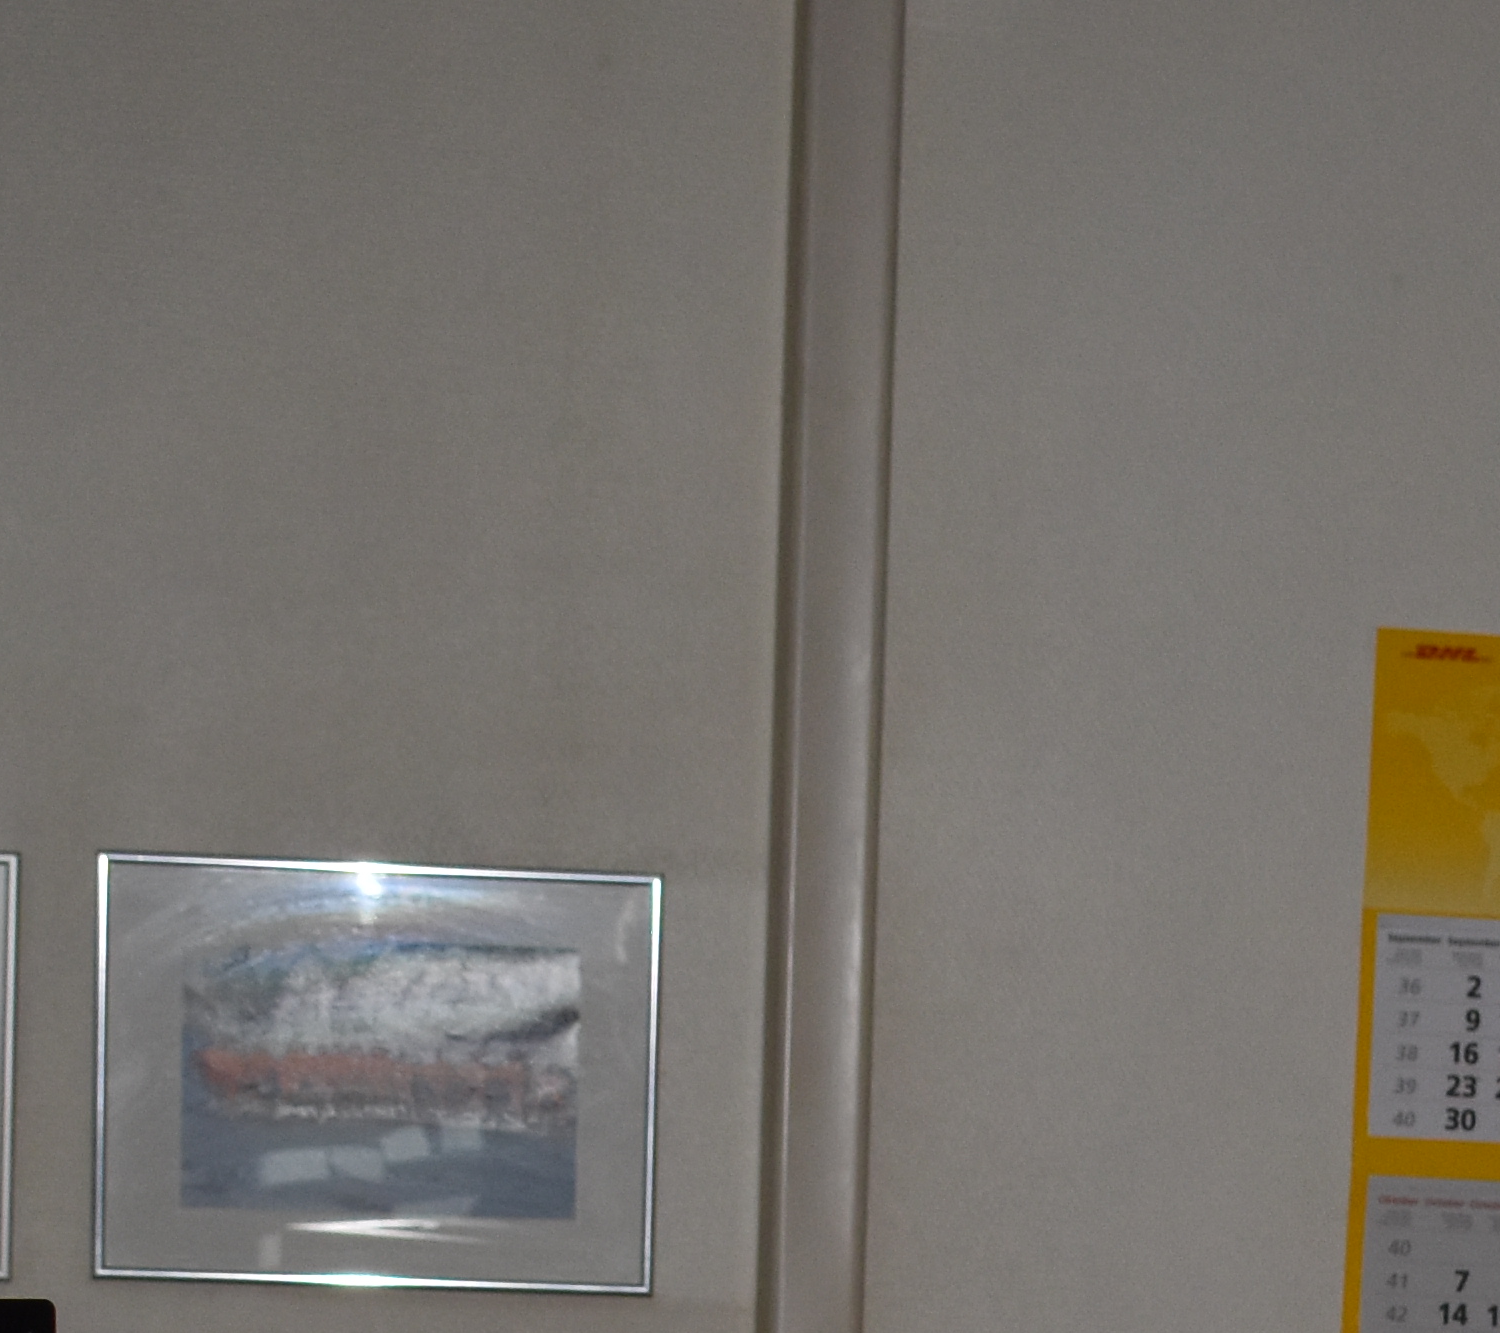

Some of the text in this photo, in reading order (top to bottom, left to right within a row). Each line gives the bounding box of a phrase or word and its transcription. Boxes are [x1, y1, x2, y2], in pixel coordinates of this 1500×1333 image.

[1467, 975, 1481, 999] 2
[1466, 1009, 1481, 1032] 9
[1450, 1042, 1479, 1065] 16
[1446, 1074, 1477, 1098] 23
[1445, 1107, 1476, 1131] 30
[1455, 1270, 1470, 1292] 7
[1440, 1303, 1468, 1325] 14
